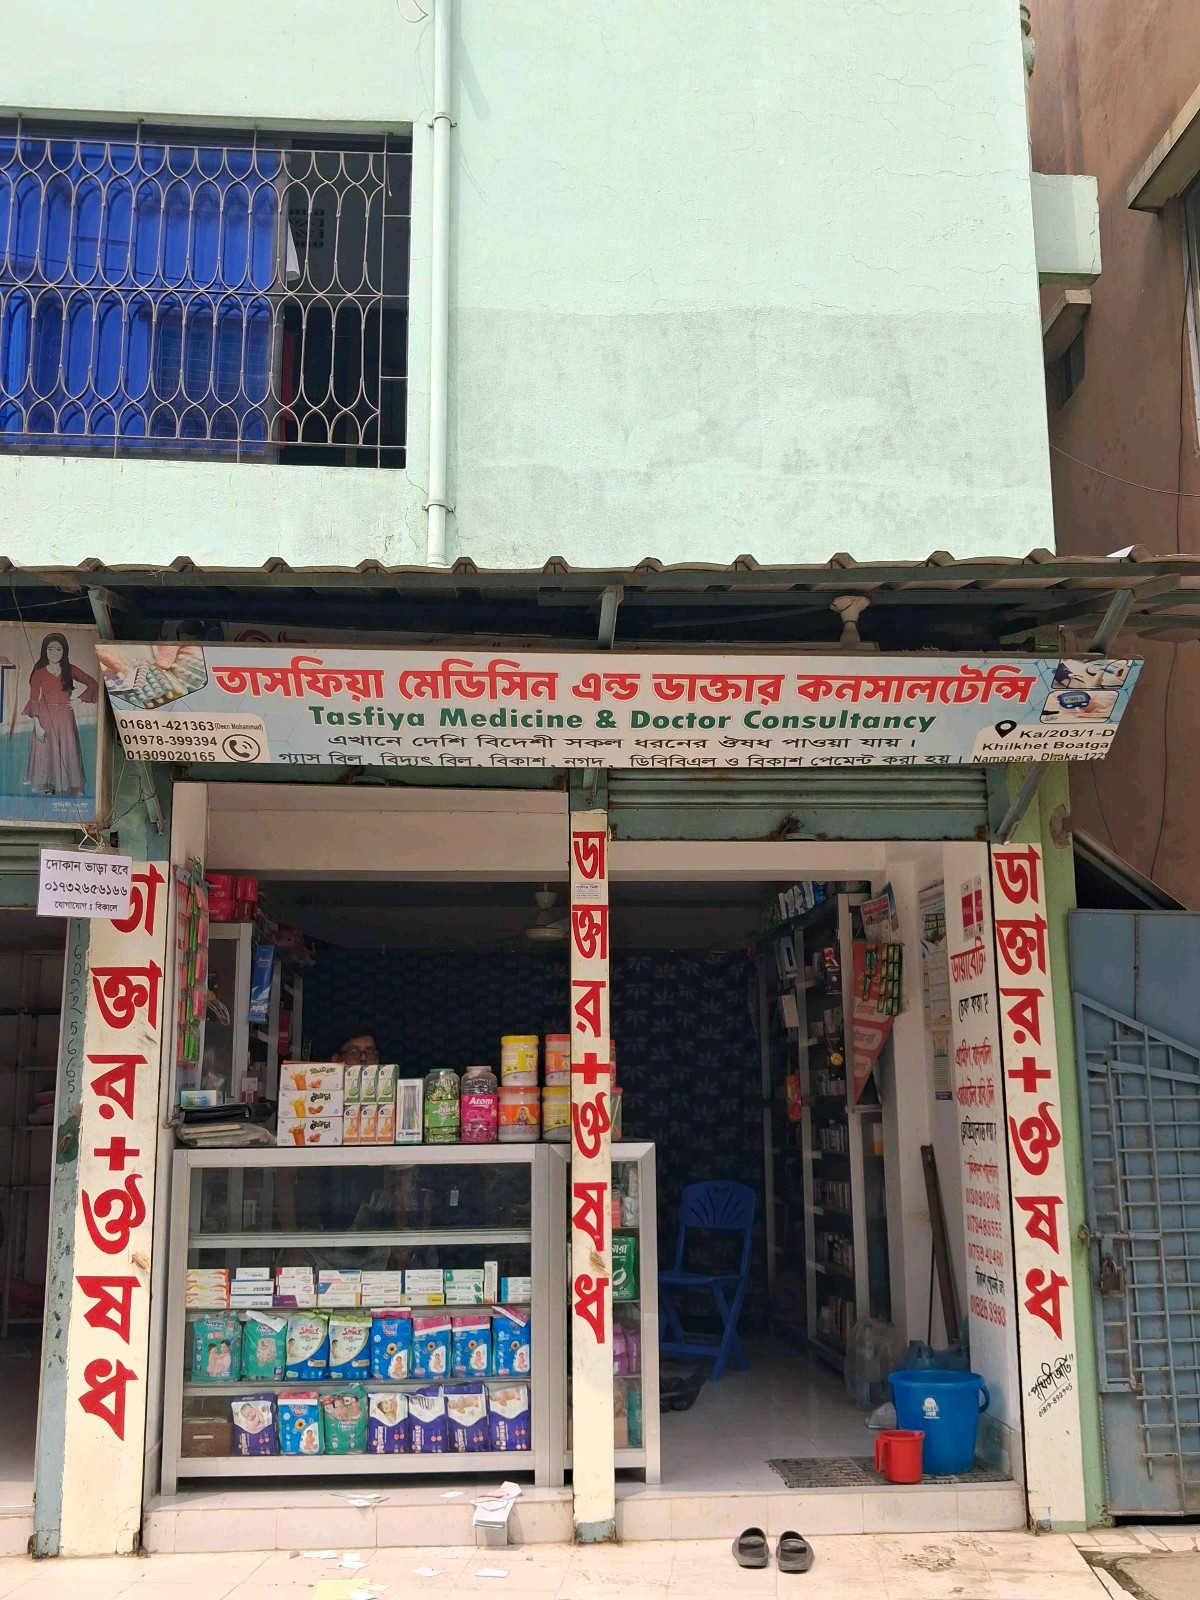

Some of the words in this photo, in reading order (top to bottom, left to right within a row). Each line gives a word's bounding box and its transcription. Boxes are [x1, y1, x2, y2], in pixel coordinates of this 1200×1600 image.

[212, 656, 384, 702] তাসফিয়া
[399, 658, 558, 701] মেডিসিন
[571, 672, 641, 702] এন্ড
[651, 673, 785, 706] ডাক্তার
[797, 664, 1036, 705] কনসালটেন্সি
[119, 719, 215, 731] 01681-421363
[308, 706, 425, 731] Tasfiya
[439, 707, 583, 729] Medicine
[595, 709, 617, 729] &
[630, 709, 731, 730] Doctor
[743, 709, 936, 733] Consultancy
[124, 734, 217, 746] 01978-399394
[1019, 729, 1115, 739] Ka/203/1-D
[328, 735, 402, 748] এখানে
[412, 733, 469, 748] দেশি
[474, 733, 555, 749] বিদেশী
[565, 737, 625, 749] সকল
[634, 737, 709, 749] ধরনের
[718, 735, 773, 749] ঔষধ
[782, 737, 852, 749] পাওয়া
[858, 738, 903, 749] যায়
[982, 742, 1049, 751] Khilkhet
[127, 750, 215, 761] 01309020165
[278, 752, 322, 766] গ্যাস
[379, 751, 434, 767] বিদ্যৎ
[629, 754, 717, 768] ডিবিবিএল
[724, 757, 739, 767] ও
[748, 754, 803, 768] বিকাশ
[811, 754, 875, 767] পেমেন্ট
[881, 755, 918, 766] করা
[45, 859, 81, 873] দোকান
[83, 862, 108, 876] ভাড়া
[111, 864, 129, 876] হবে
[45, 881, 128, 896] ০১৭৩২৬৫৬১৬৬
[54, 901, 87, 911] যোগাযোগ
